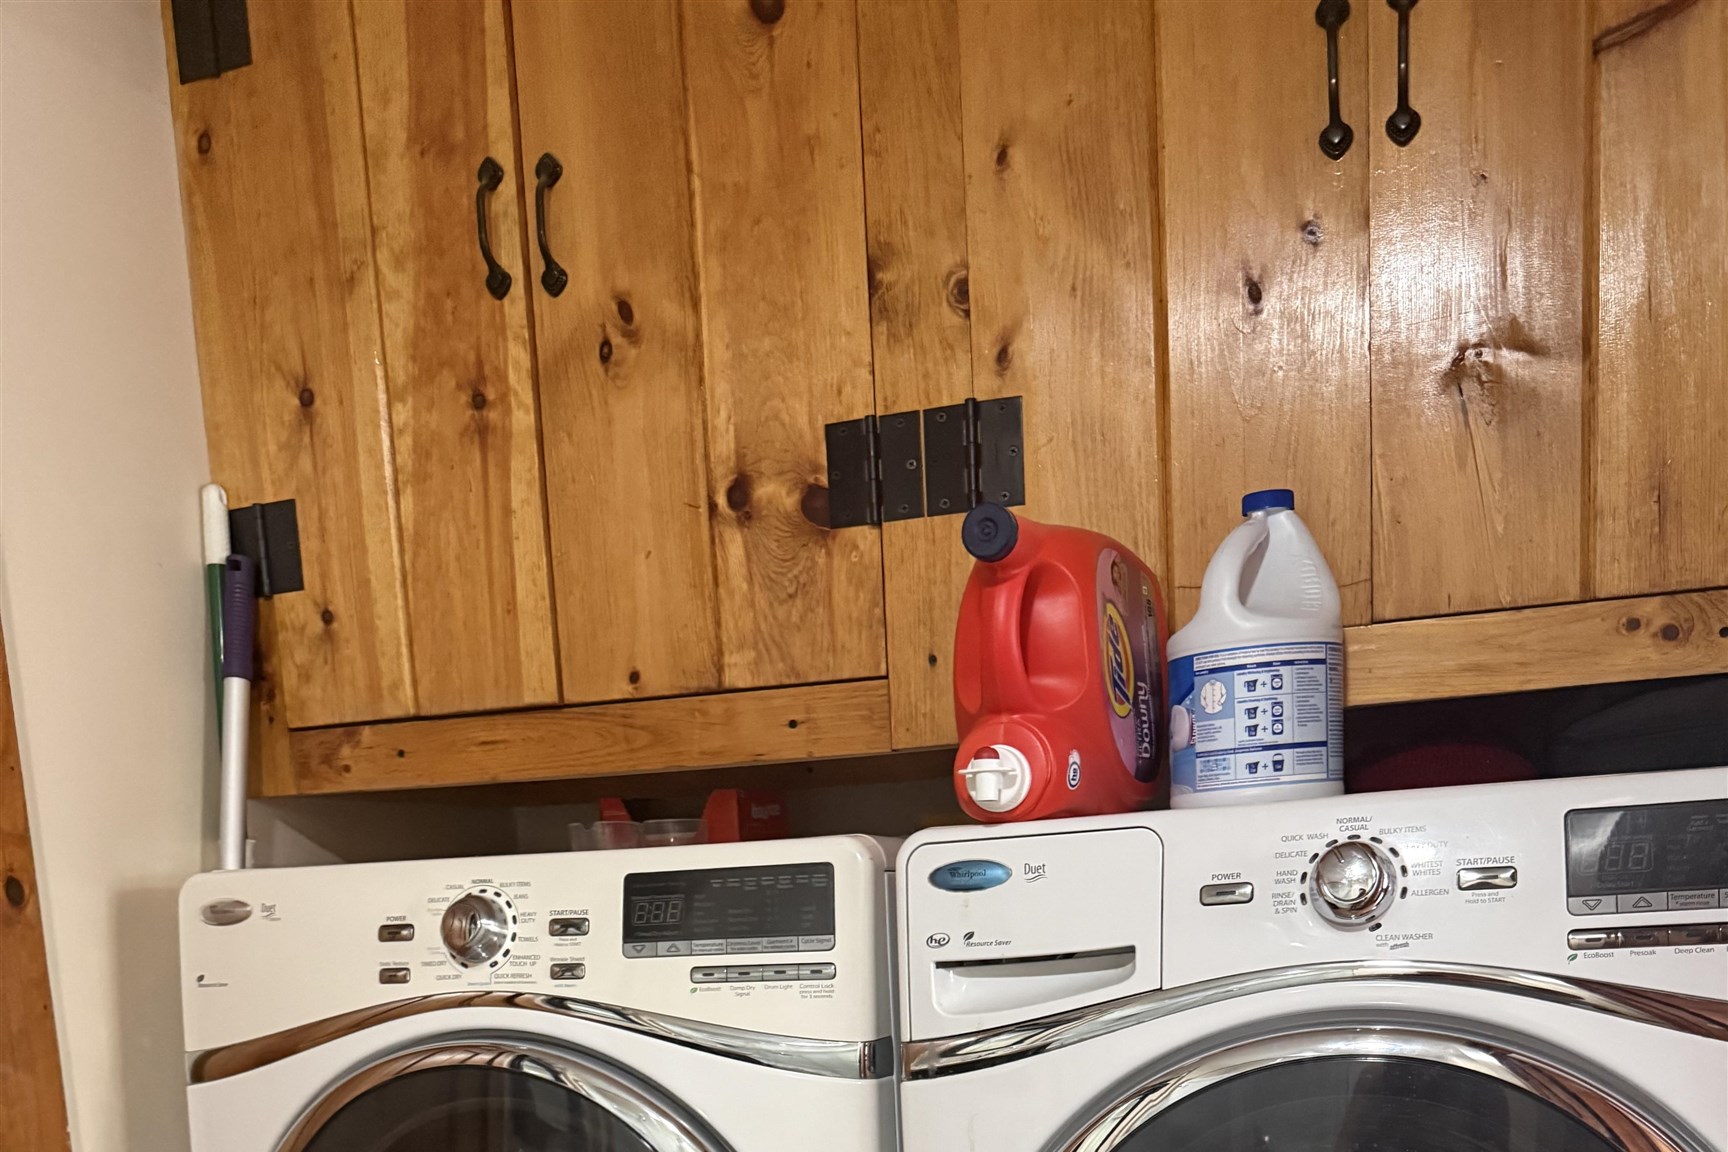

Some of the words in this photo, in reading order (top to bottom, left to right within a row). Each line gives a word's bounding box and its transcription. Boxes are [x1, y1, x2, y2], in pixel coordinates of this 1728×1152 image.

[1106, 613, 1132, 710] Tide
[1137, 681, 1150, 758] Downy
[1336, 816, 1373, 825] NORMAL/
[1339, 824, 1369, 832] CASUAL
[1379, 827, 1403, 835] BULKY
[1404, 825, 1427, 833] ITEMS
[1281, 834, 1304, 843] QUICK
[1307, 833, 1329, 841] WASH
[1274, 851, 1308, 859] DELICATE
[1411, 861, 1443, 869] WHITEST
[1456, 855, 1516, 866] START/PAUSE
[949, 869, 986, 879] Whirlpool
[1024, 863, 1046, 875] Duet
[1211, 872, 1241, 881] POWER
[1272, 892, 1295, 900] RINSE/
[1670, 893, 1716, 901] Temperature
[929, 935, 946, 946] he
[1375, 934, 1400, 942] CLEAN
[1402, 932, 1433, 941] WASHER
[966, 940, 993, 948] Resource
